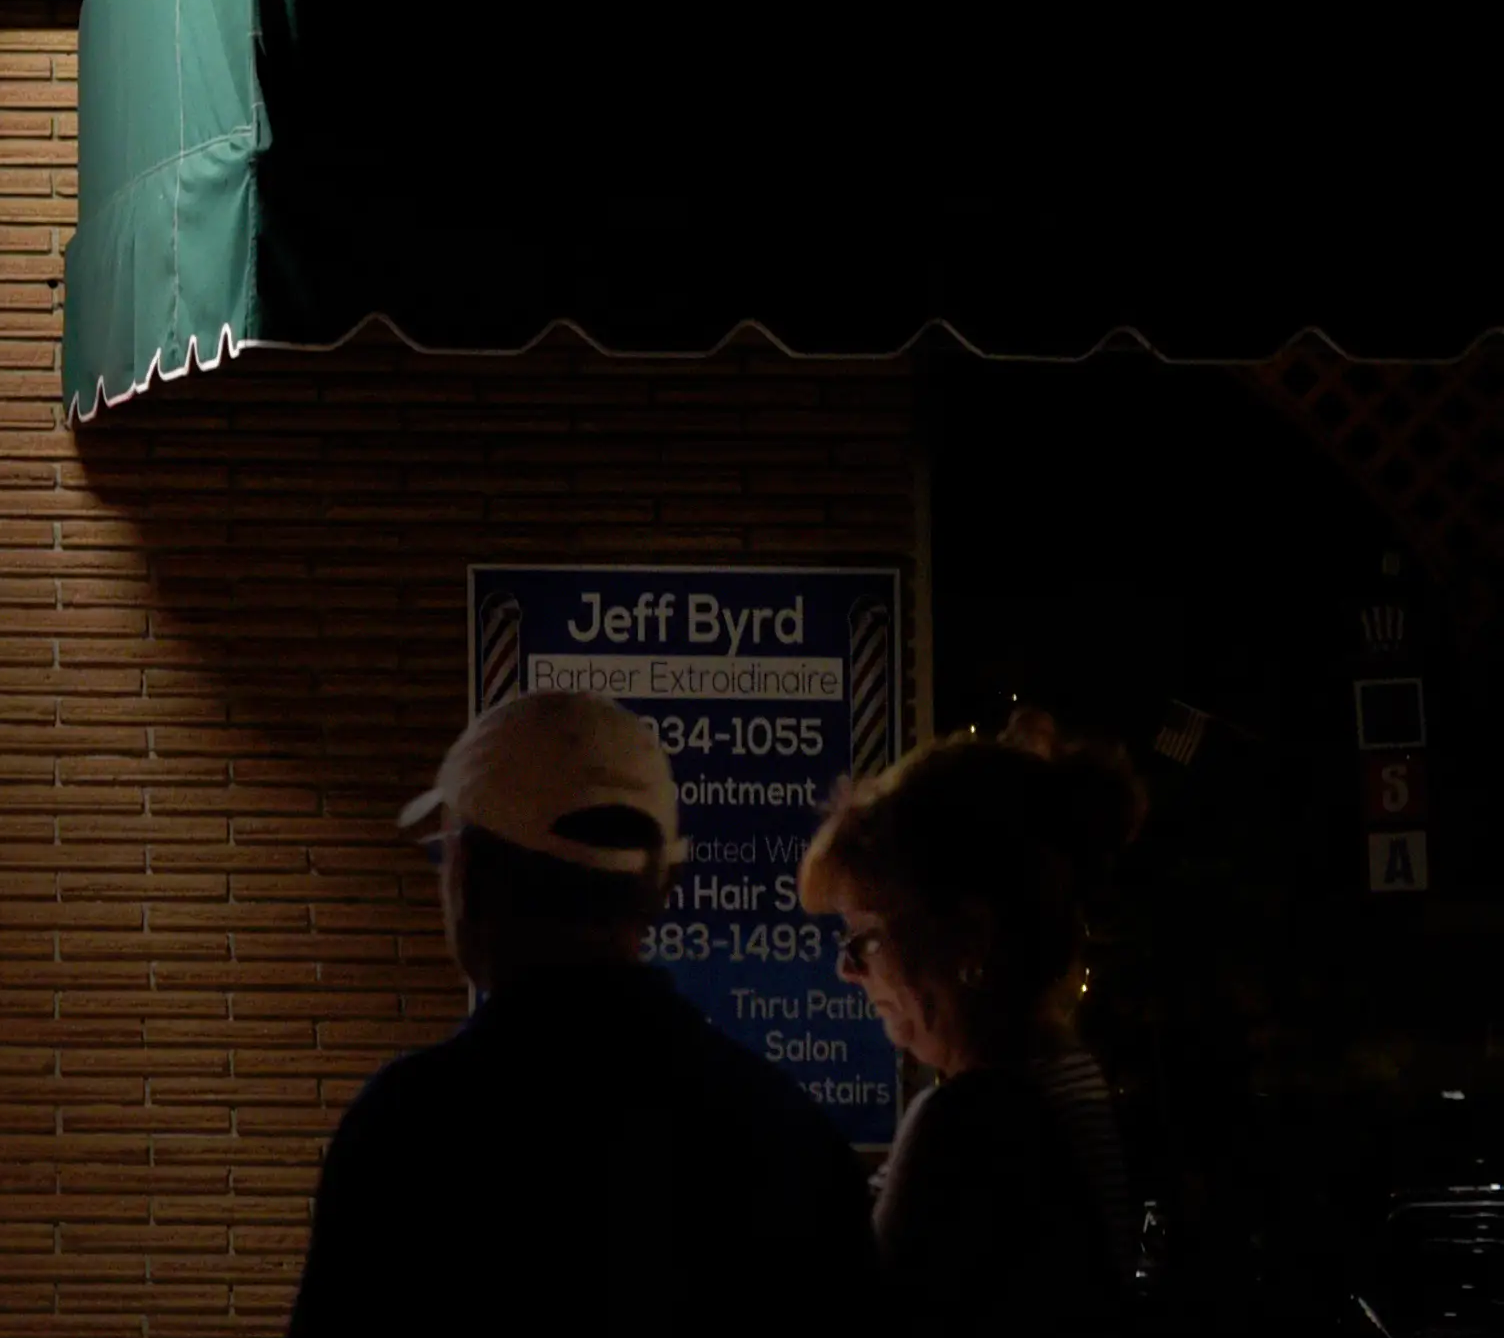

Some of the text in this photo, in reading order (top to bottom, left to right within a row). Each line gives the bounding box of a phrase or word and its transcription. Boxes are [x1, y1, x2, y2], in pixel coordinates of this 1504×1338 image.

[567, 592, 803, 656] Jeff Byrd
[534, 660, 839, 695] Barber Extroidinaire
[676, 774, 817, 807] ointment
[765, 835, 809, 864] Wit
[693, 875, 768, 911] Hair
[731, 988, 799, 1020] Thru
[764, 1029, 849, 1063] Salon
[798, 1074, 892, 1105] stairs
